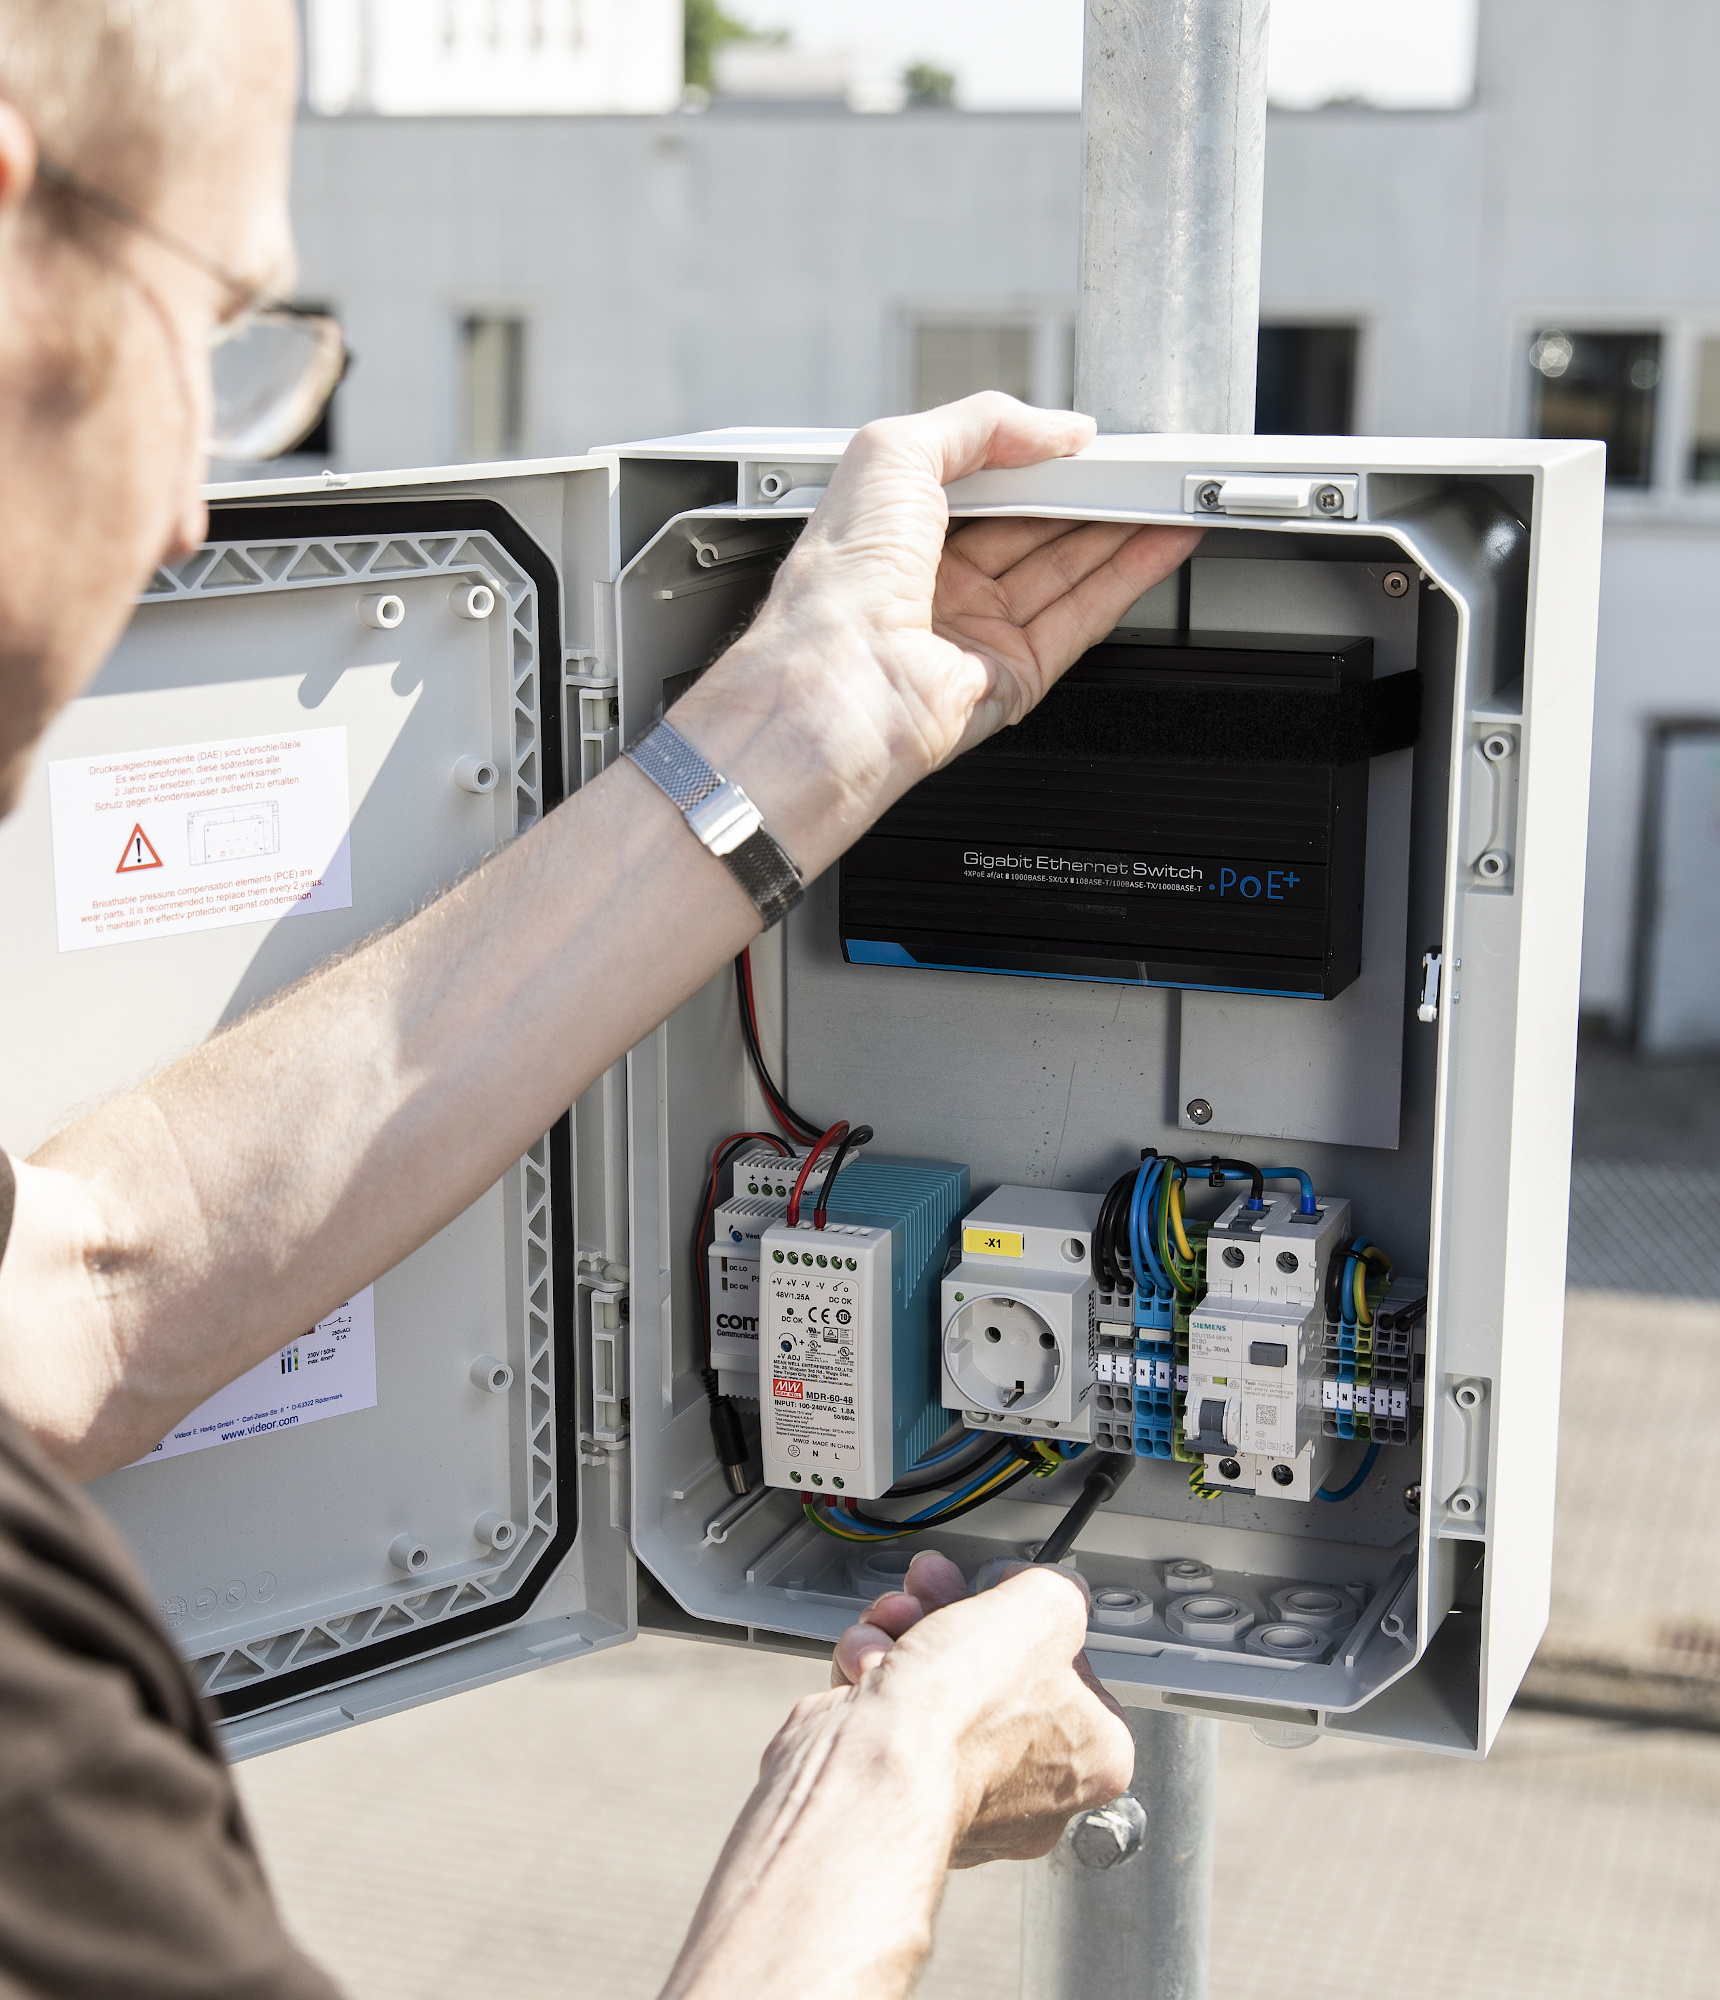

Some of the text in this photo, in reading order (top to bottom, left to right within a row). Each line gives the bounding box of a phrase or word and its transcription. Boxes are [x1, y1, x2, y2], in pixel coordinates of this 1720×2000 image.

[90, 754, 195, 775] Druckausgleichselemente
[198, 750, 222, 763] (DAE)
[224, 748, 241, 758] sind
[116, 775, 127, 784] Es
[129, 771, 146, 782] wird
[196, 762, 218, 774] diese
[220, 757, 264, 771] spätestens
[266, 755, 280, 764] alle
[114, 788, 120, 796] 2
[122, 784, 145, 795] Jahre
[148, 784, 158, 792] zu
[200, 776, 213, 785] um
[215, 773, 237, 783] einen
[239, 767, 282, 780] wirksamen
[94, 800, 123, 811] Schutz
[126, 796, 151, 809] gegen
[154, 787, 218, 803] Kondenswasser
[221, 783, 253, 795] aufrecht
[255, 781, 265, 789] zu
[964, 851, 1203, 880] Gigabit Ethernet Switch
[92, 868, 313, 909] Breathable pressure compensation elements (PCE) are
[964, 870, 1202, 892] 4XPoE af/at 1000BASE-SX/LX 10BASE-T/100BASE-TX/1000BASE-T
[80, 913, 101, 923] wear
[129, 907, 135, 916] It
[137, 905, 144, 914] is
[146, 895, 203, 913] recommended
[206, 894, 214, 903] to
[216, 890, 245, 904] replace
[247, 886, 267, 897] them
[269, 883, 291, 897] every
[293, 881, 298, 890] 2
[300, 878, 325, 892] years,
[95, 891, 312, 932] to maintain an effectiv protection against condensation
[984, 1238, 1001, 1249] -X1
[776, 1291, 810, 1301] 48V/1.25A
[1244, 1284, 1277, 1296] 1 N
[1192, 1322, 1226, 1332] SIEMENS
[775, 1380, 801, 1392] MW
[1179, 1374, 1187, 1383] PE
[774, 1400, 797, 1408] INPUT:
[799, 1402, 837, 1412] 100-240VAC
[806, 1391, 853, 1403] MDR-60-48
[1358, 1396, 1367, 1404] PE
[174, 1430, 191, 1440] Videor
[200, 1424, 216, 1434] Hartig
[217, 1420, 234, 1429] GmbH
[315, 1393, 343, 1404] Rödermark
[221, 1415, 299, 1441] www.videor.com
